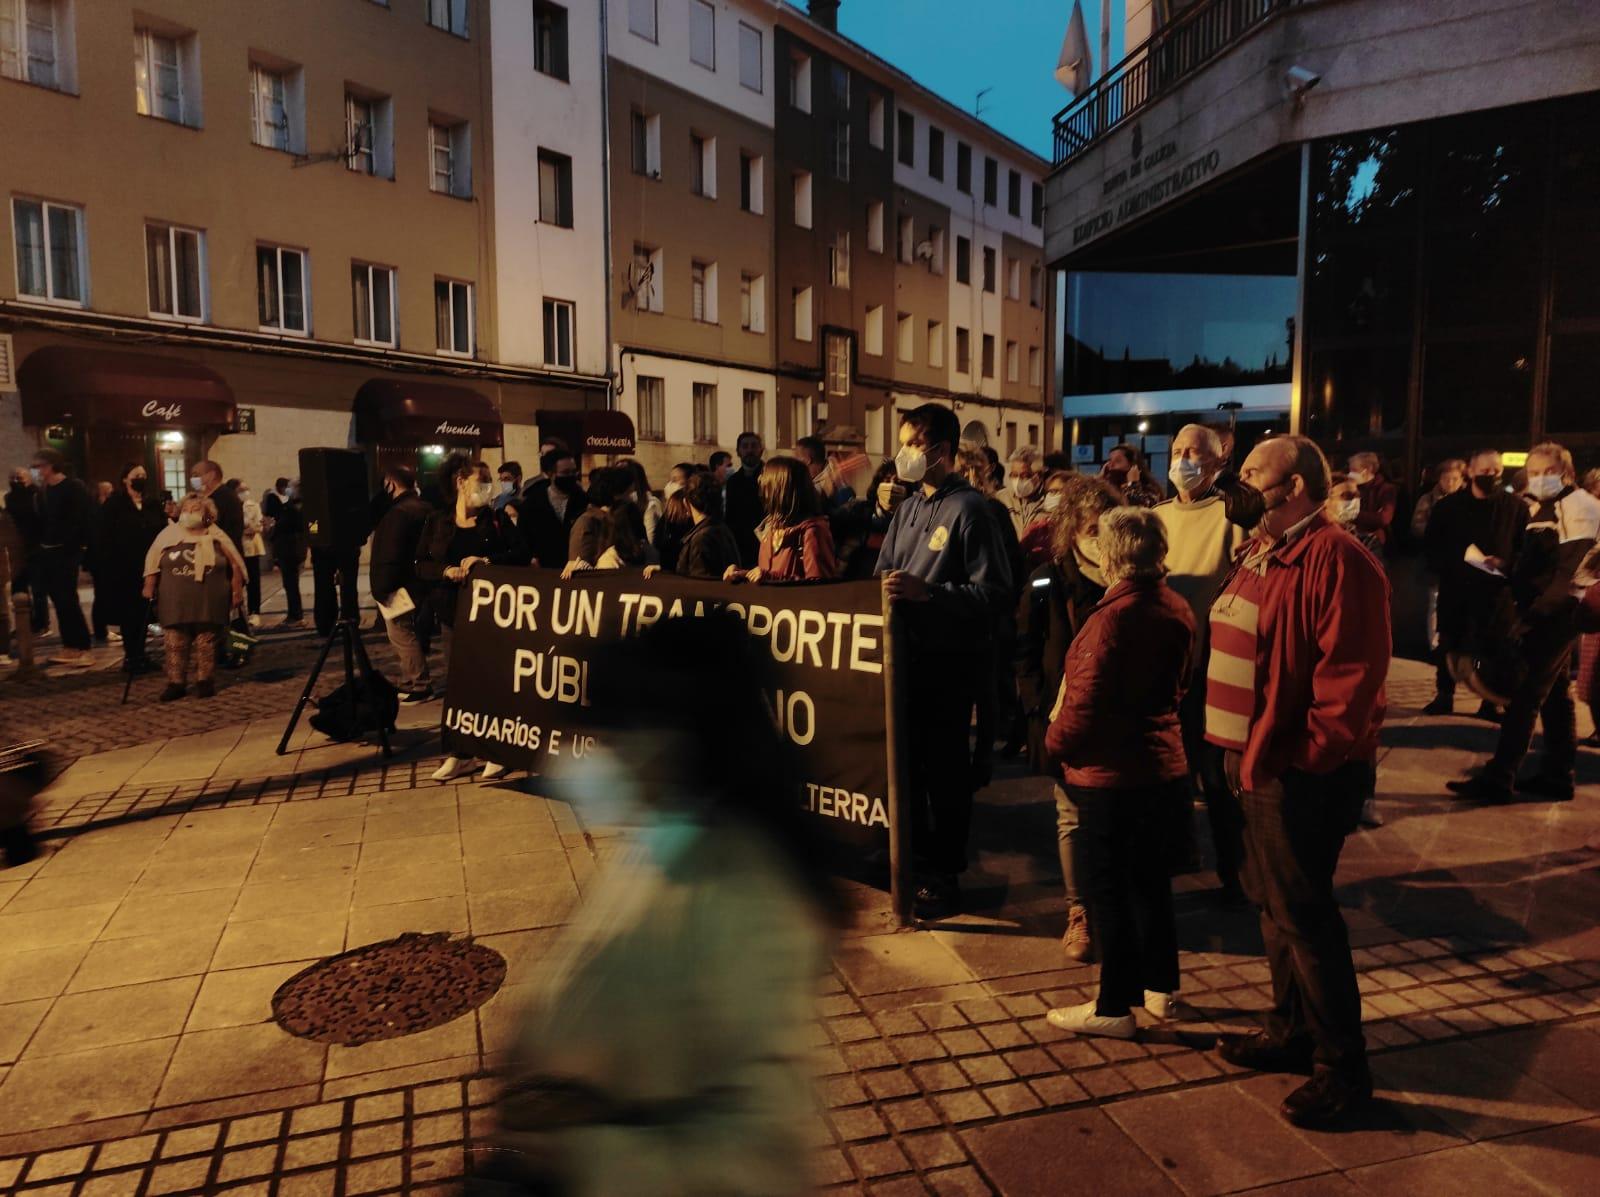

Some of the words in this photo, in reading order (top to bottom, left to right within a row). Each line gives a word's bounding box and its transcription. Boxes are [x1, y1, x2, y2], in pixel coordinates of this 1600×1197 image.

[1073, 209, 1114, 246] EDIFICIO
[1116, 149, 1220, 222] ADMINISTRATIVO
[142, 400, 181, 421] Café
[435, 420, 481, 436] Avenida
[469, 578, 538, 631] POR
[551, 587, 604, 638] UN
[548, 729, 563, 756] E
